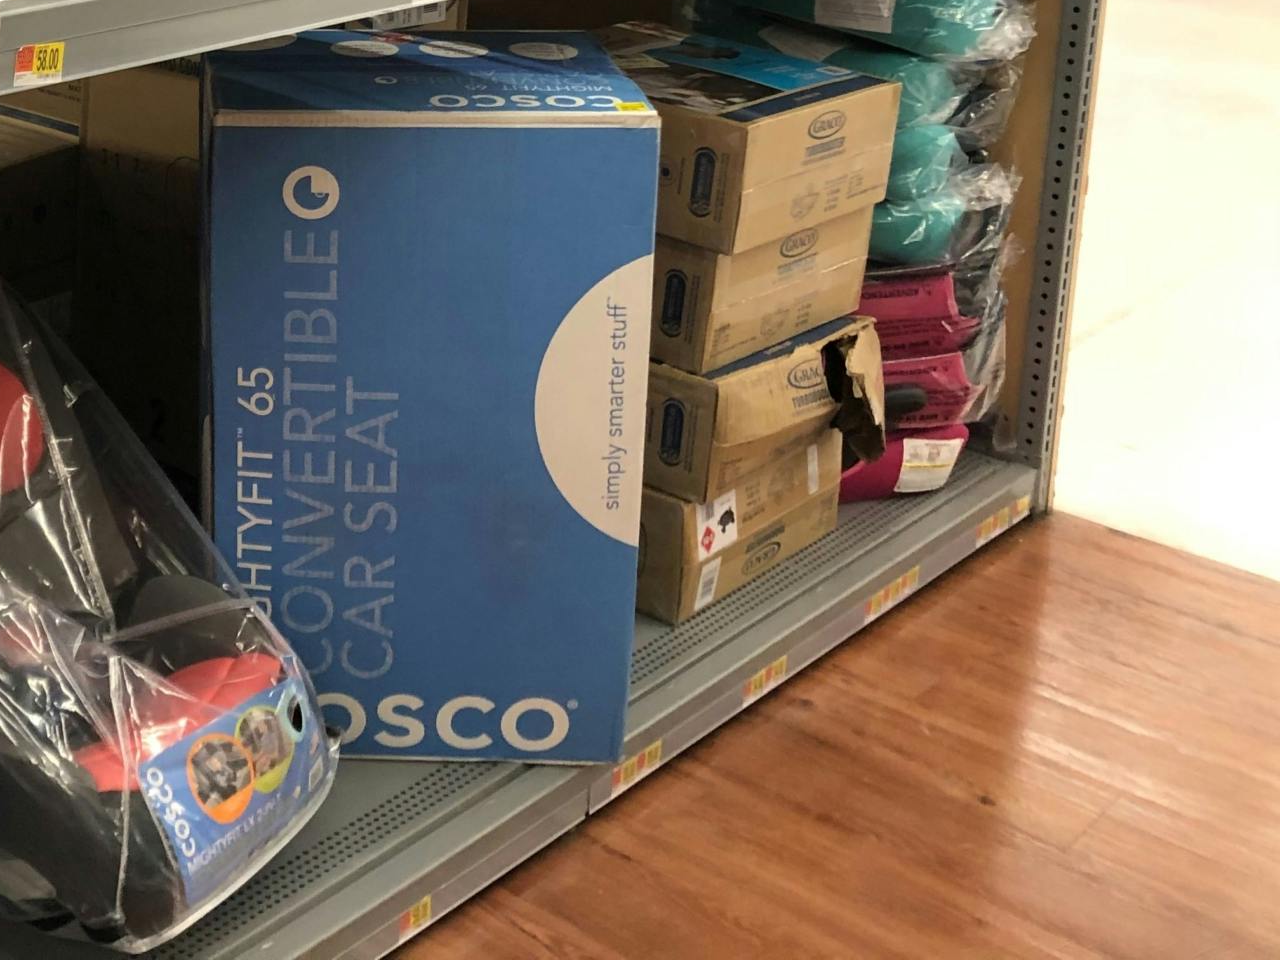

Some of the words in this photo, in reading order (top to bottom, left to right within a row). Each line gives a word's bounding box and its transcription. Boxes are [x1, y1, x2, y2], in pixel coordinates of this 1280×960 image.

[36, 47, 59, 72] 58.00
[428, 93, 623, 110] COSCO
[606, 296, 627, 352] stuff
[236, 366, 274, 417] 65
[605, 361, 627, 438] smarter
[343, 375, 400, 535] SEAT
[600, 444, 627, 511] simply
[341, 555, 396, 680] CAR
[317, 692, 579, 753] OSCO®
